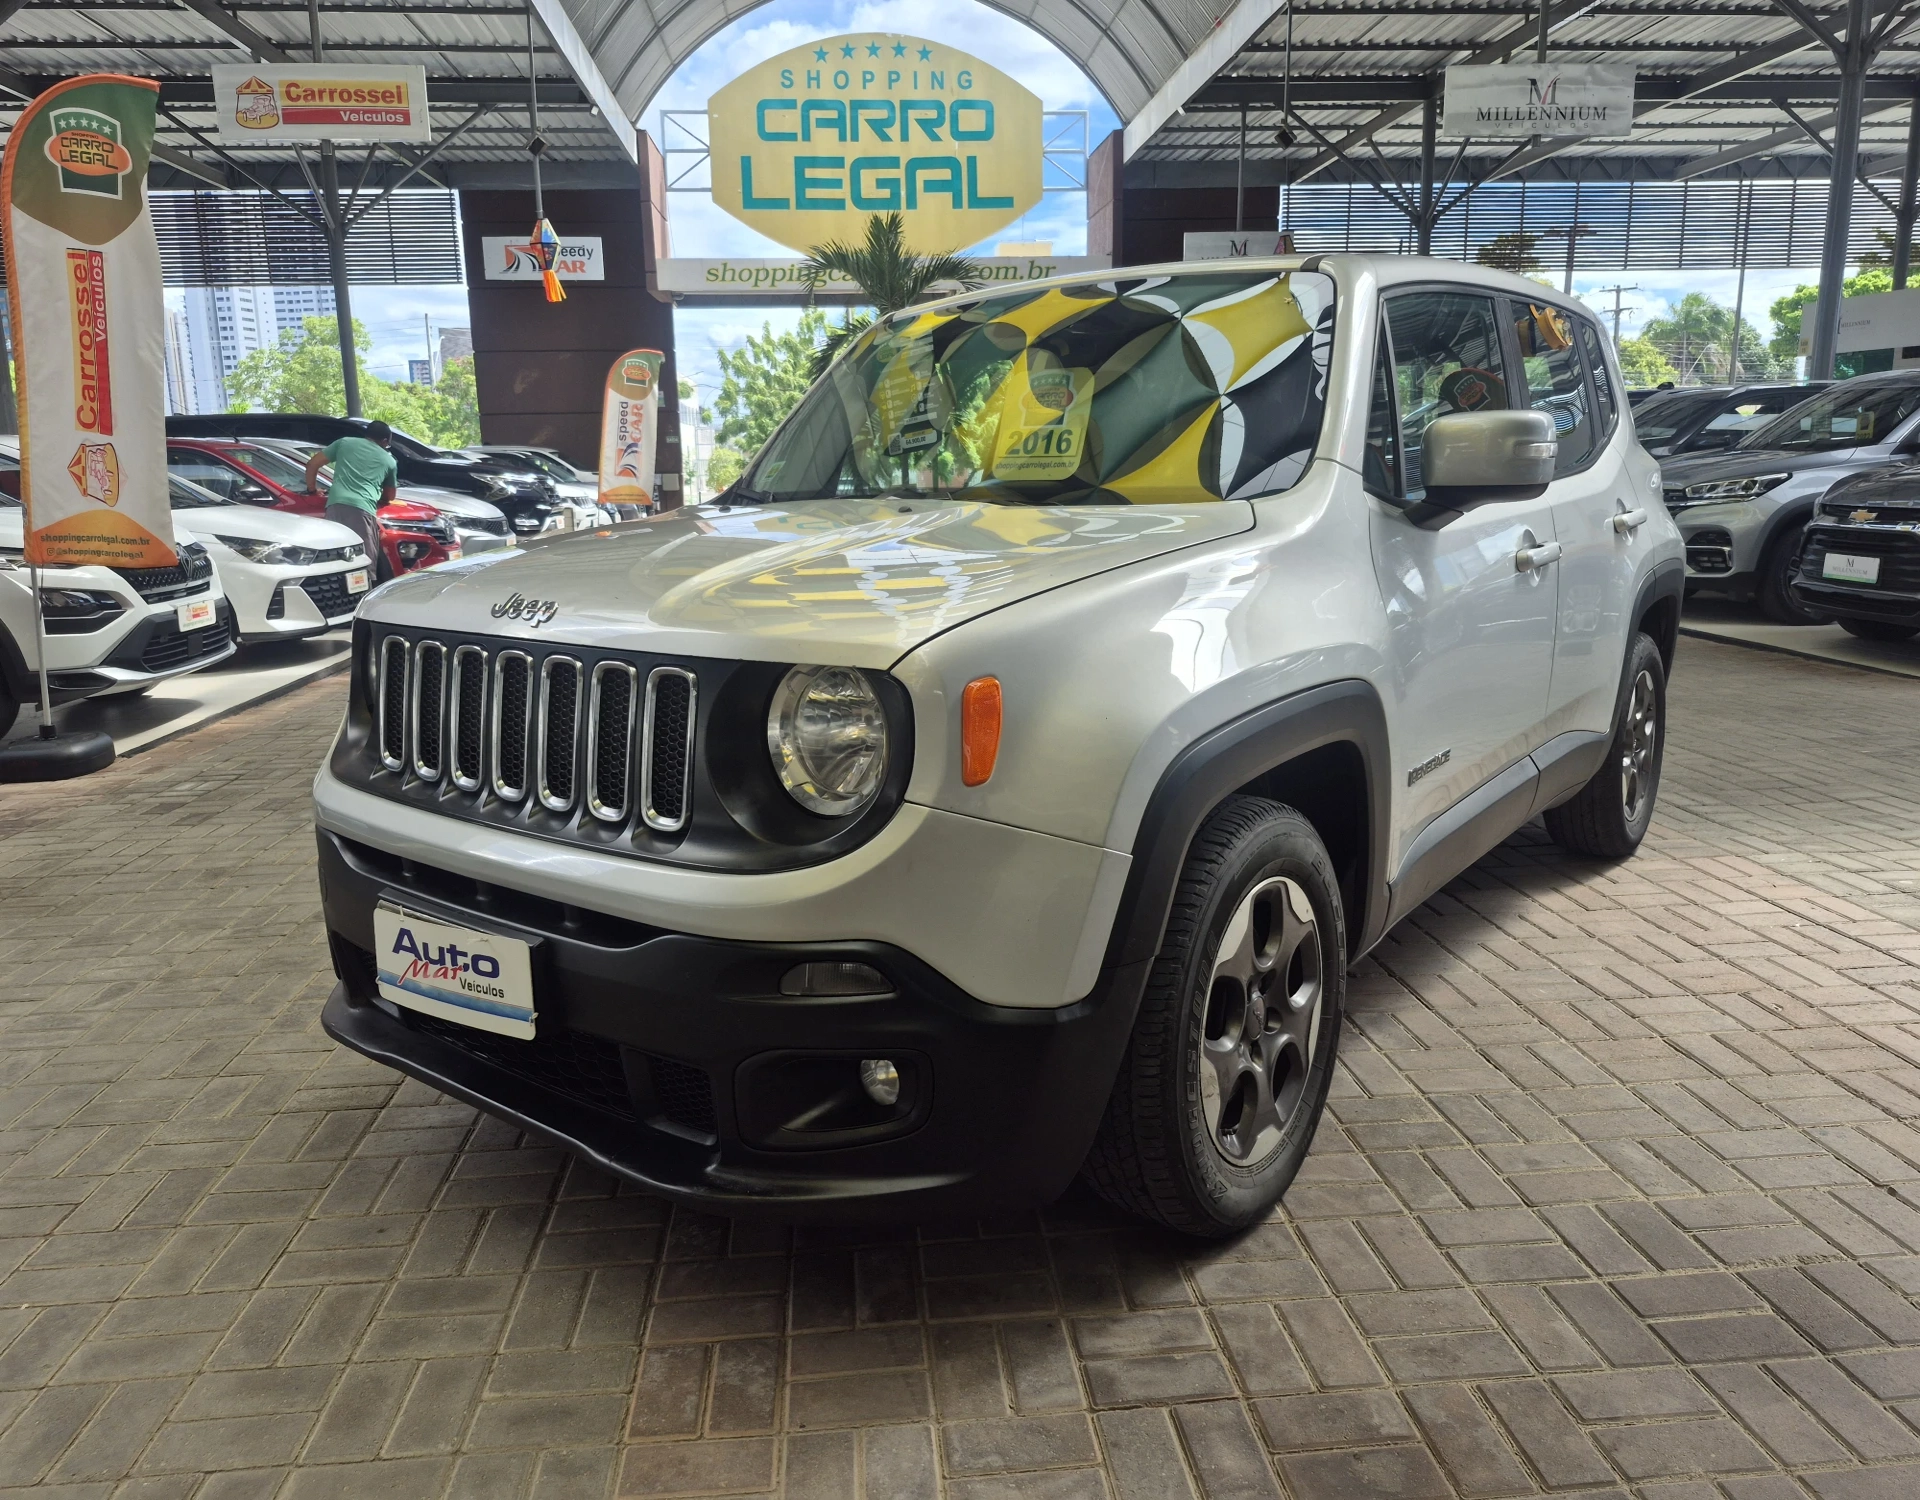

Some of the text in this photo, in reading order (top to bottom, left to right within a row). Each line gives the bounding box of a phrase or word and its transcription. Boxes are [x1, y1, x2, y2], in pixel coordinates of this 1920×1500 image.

[780, 69, 973, 91] SHOPPING
[285, 82, 403, 104] Carrossel
[340, 110, 404, 123] Veículos
[756, 98, 995, 142] CARRO
[1476, 106, 1608, 121] MILLENNIUM
[60, 137, 114, 153] CARRO
[59, 149, 119, 170] LEGAL
[740, 156, 1014, 210] LEGAL
[558, 245, 594, 260] eedy
[555, 259, 587, 274] AR
[90, 254, 108, 343] Veículos
[67, 251, 97, 430] Carrossel
[1004, 429, 1074, 455] 2016
[40, 532, 151, 546] shoppingcarrolegal.com.br
[491, 592, 559, 628] Jeep
[392, 927, 500, 979] Auto
[397, 959, 464, 985] Mar
[459, 977, 505, 998] Veículos
